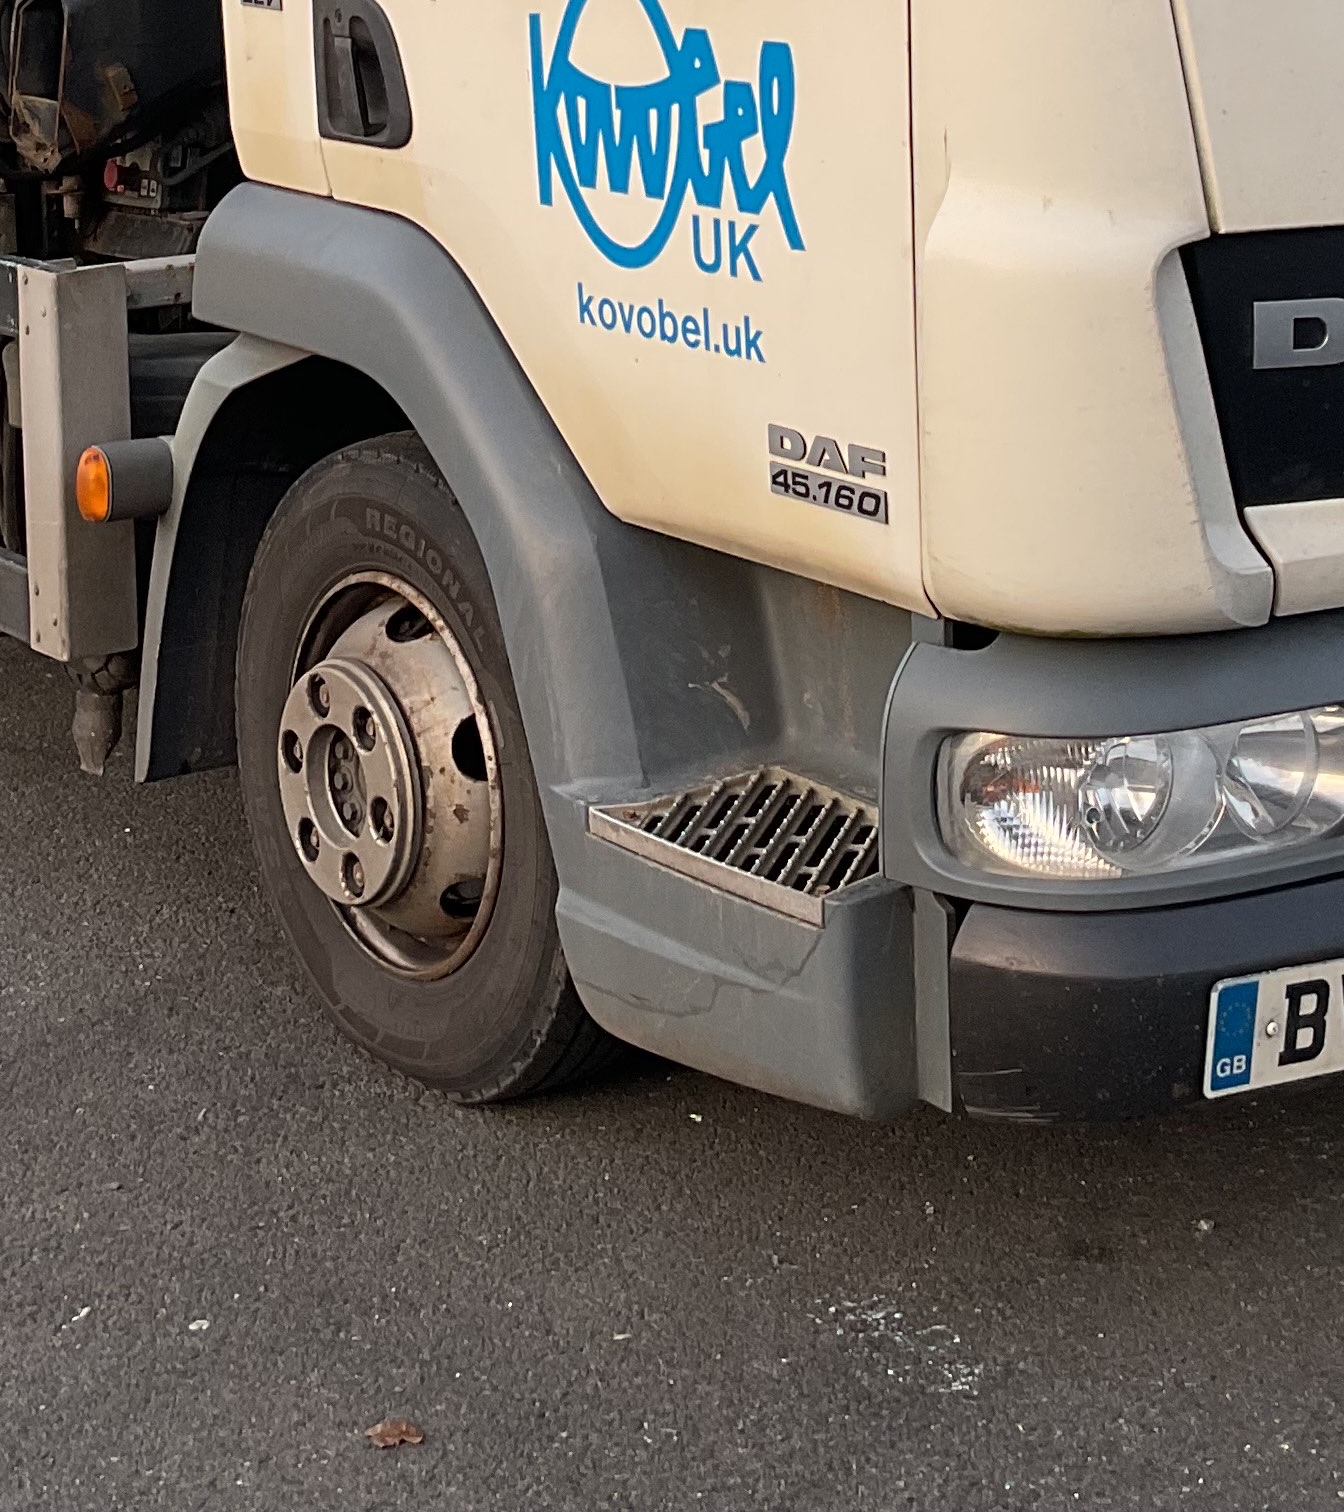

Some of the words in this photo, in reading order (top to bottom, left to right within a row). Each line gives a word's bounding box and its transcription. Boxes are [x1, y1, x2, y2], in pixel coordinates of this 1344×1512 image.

[692, 214, 763, 282] UK
[577, 281, 766, 364] kovobel.uk
[767, 423, 887, 479] DAF
[771, 468, 882, 518] 45.160
[365, 507, 488, 654] REGIONAL
[1216, 1054, 1247, 1078] GB
